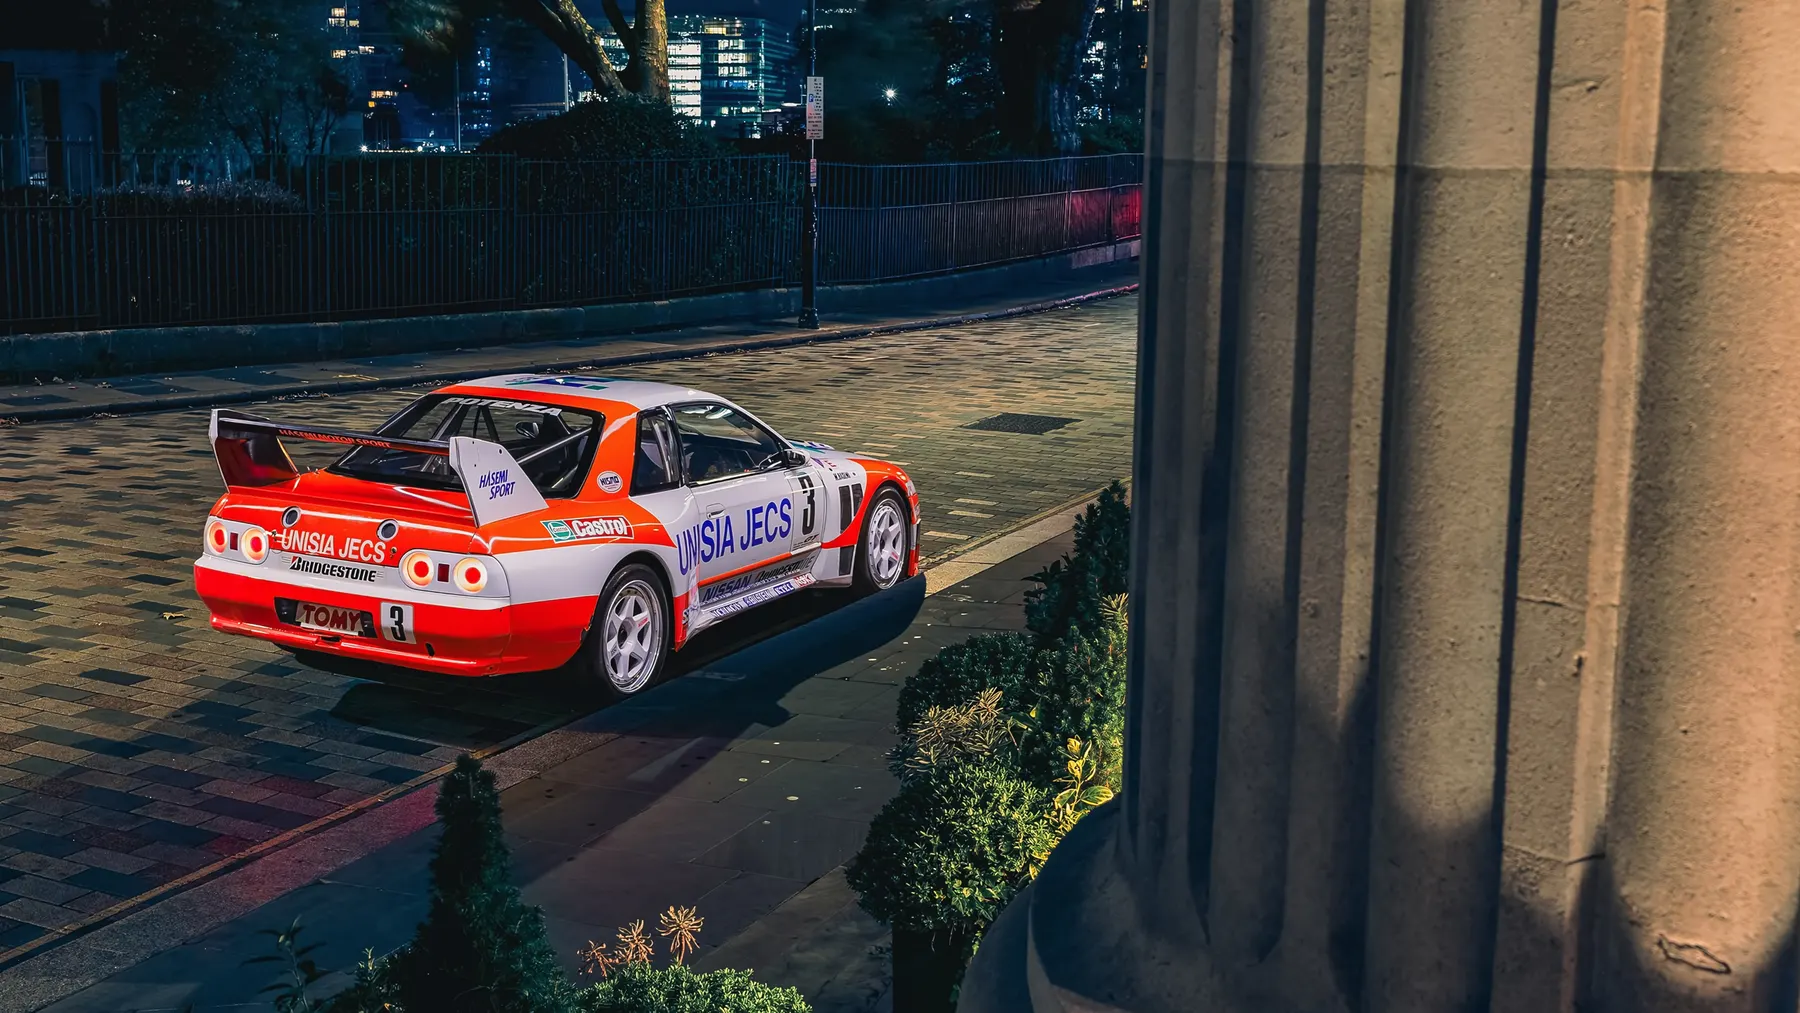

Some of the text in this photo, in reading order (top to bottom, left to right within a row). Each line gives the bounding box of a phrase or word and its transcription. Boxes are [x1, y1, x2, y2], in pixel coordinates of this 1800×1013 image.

[441, 397, 562, 416] POTENZA
[318, 433, 355, 444] MOTOR
[356, 438, 391, 448] SPORT
[479, 469, 508, 489] HASEMI
[489, 481, 516, 500] SPORT
[798, 475, 815, 535] 3
[571, 517, 628, 537] Castrol
[676, 498, 791, 575] UNISIA JECS
[281, 528, 386, 563] UNISIA JECS
[289, 556, 376, 583] BRIDGESTONE
[702, 574, 752, 601] NISSAN
[302, 604, 361, 632] TOMY
[390, 605, 406, 641] 3
